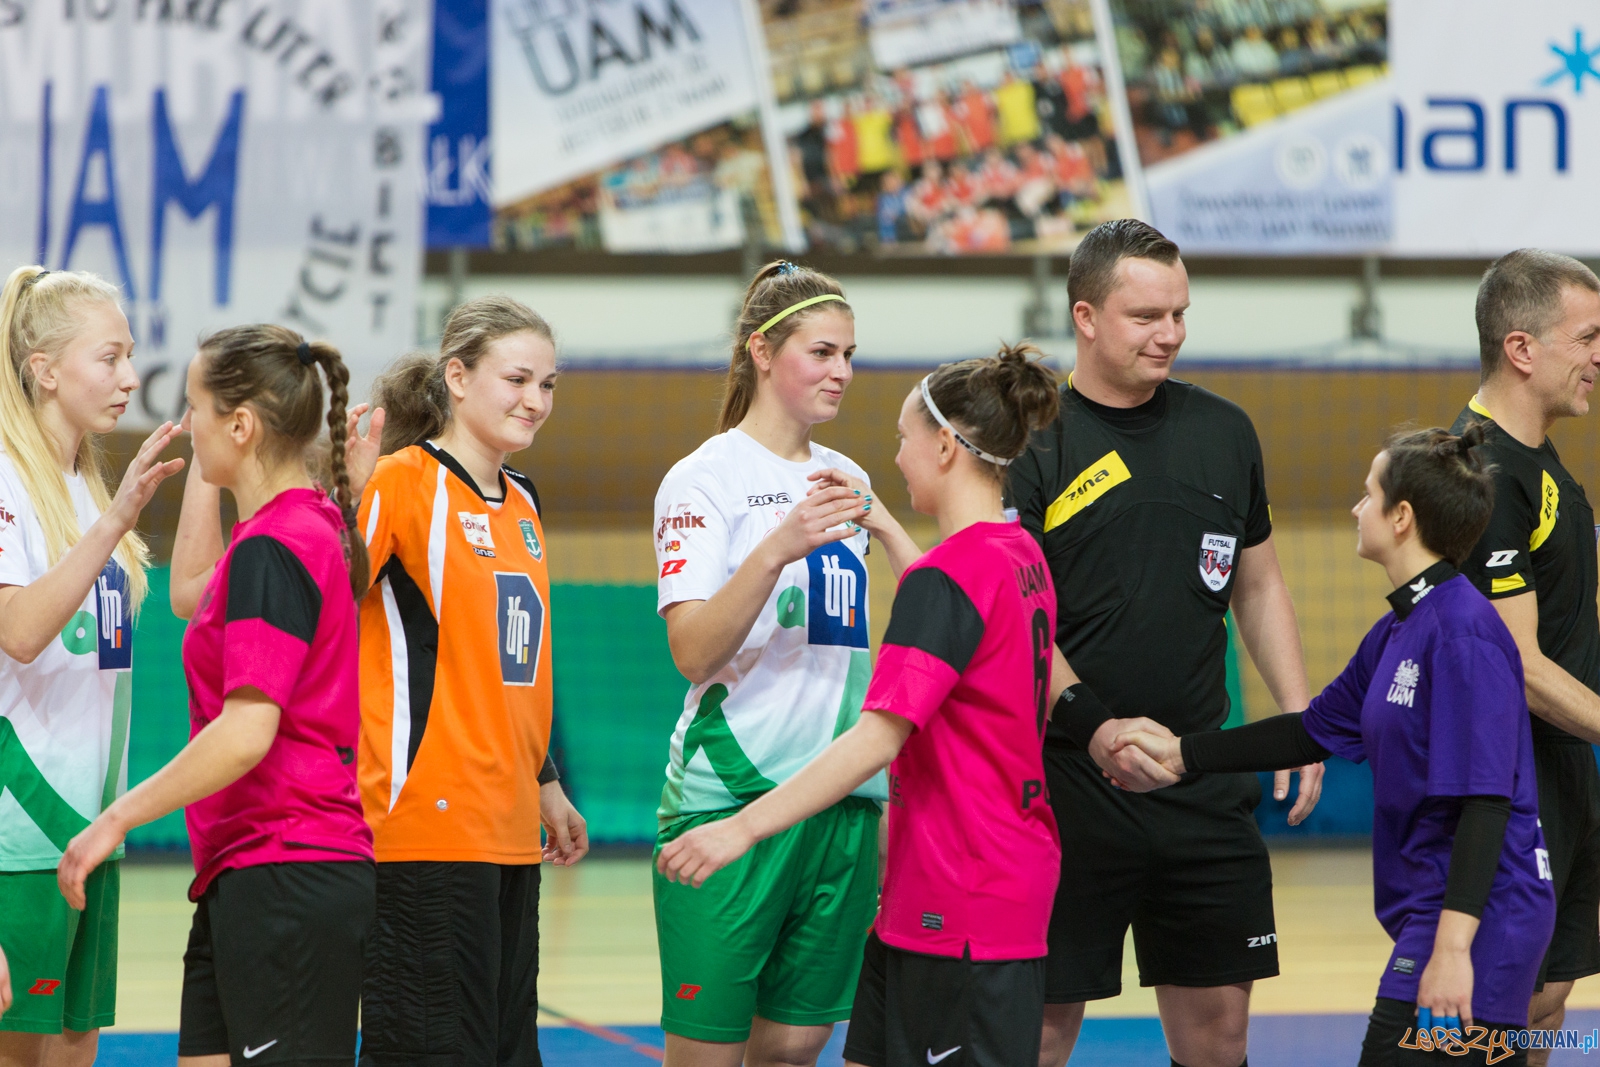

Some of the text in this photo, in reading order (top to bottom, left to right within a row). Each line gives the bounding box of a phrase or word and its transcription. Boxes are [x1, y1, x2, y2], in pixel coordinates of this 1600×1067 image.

[1065, 468, 1110, 502] zina
[747, 491, 792, 507] zina
[1208, 538, 1231, 549] FUTSAL
[1015, 562, 1049, 598] UAM
[1386, 683, 1416, 708] UAM
[1246, 933, 1277, 948] zin
